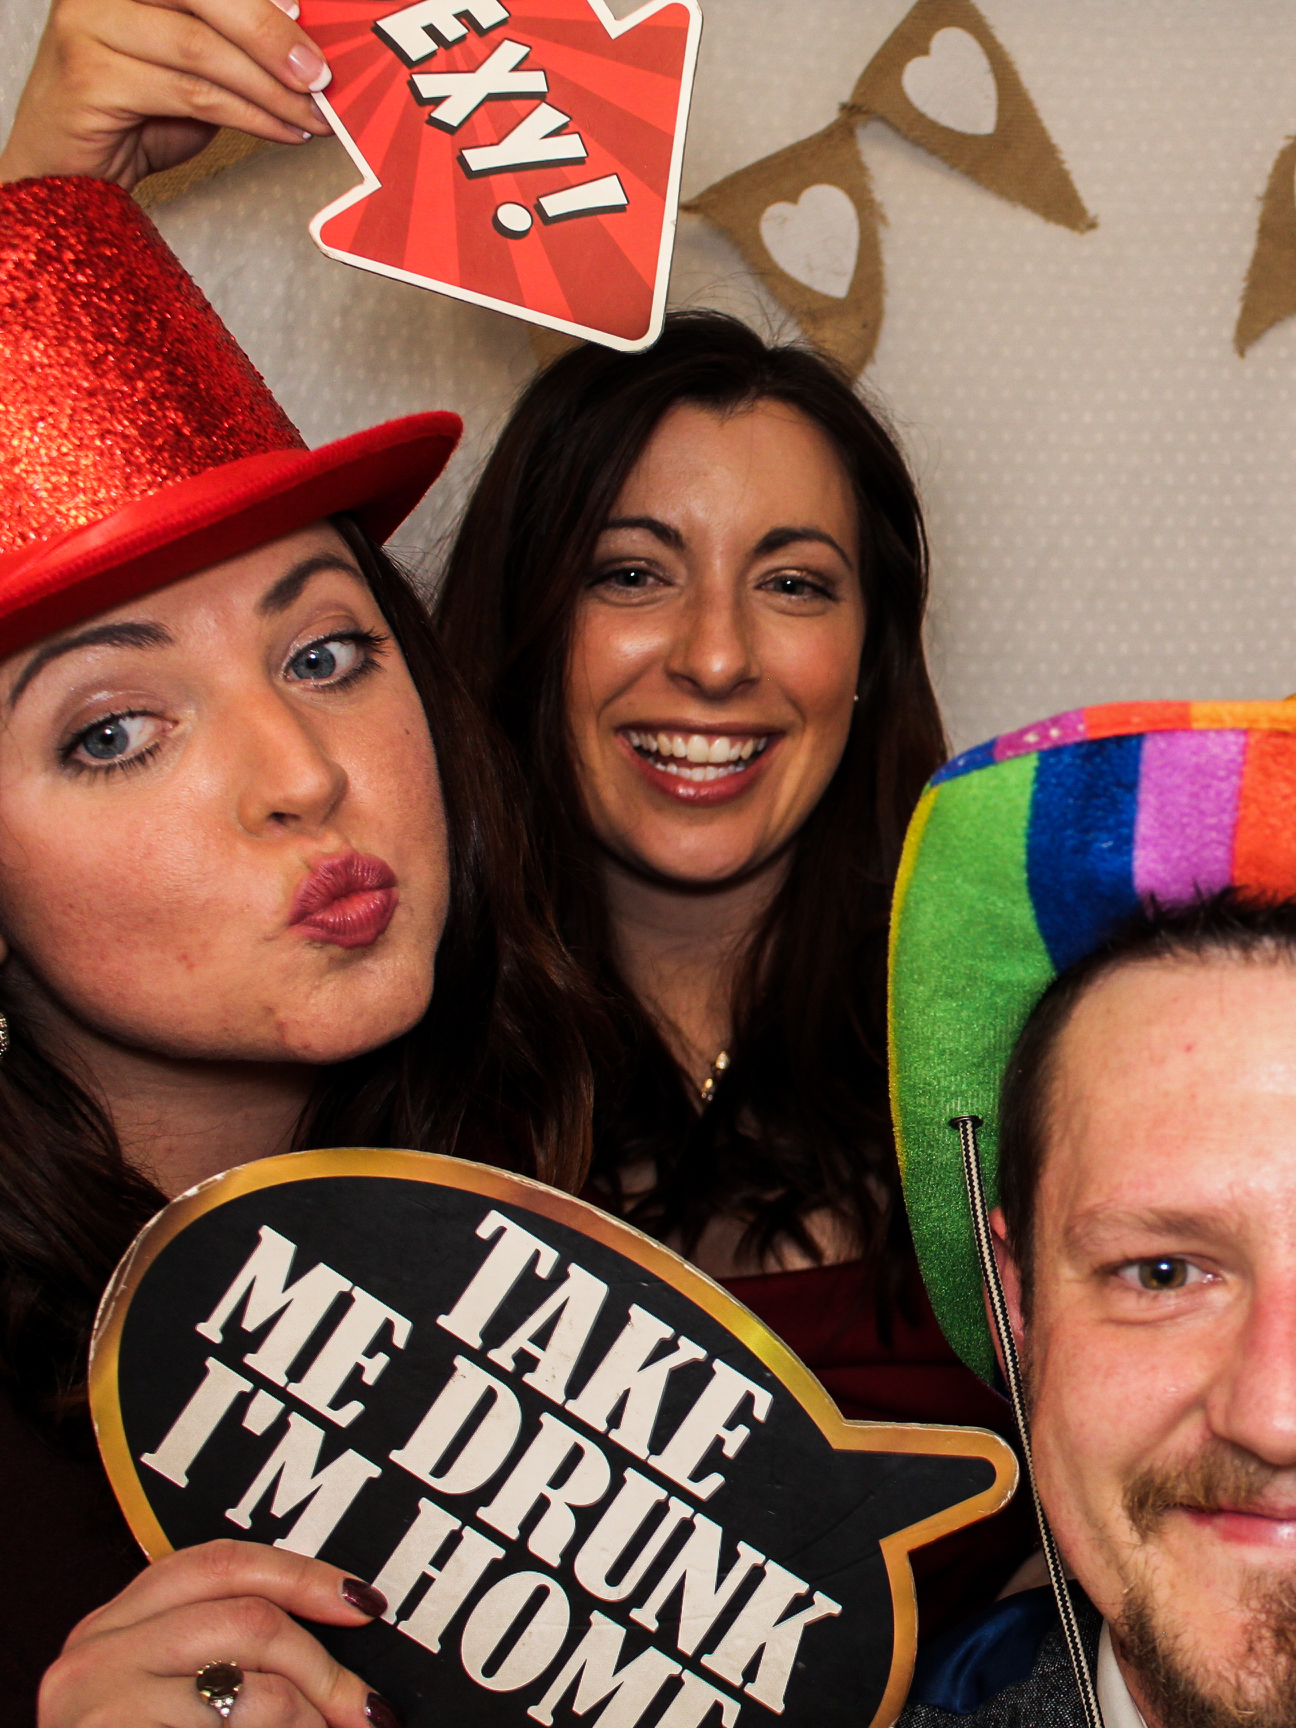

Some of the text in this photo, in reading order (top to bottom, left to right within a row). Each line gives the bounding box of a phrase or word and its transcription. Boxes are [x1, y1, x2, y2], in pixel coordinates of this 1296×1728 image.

[373, 0, 629, 236] EXY!
[140, 1356, 382, 1559] I'M
[196, 1225, 842, 1714] ME DRUNK
[437, 1209, 773, 1500] TAKE
